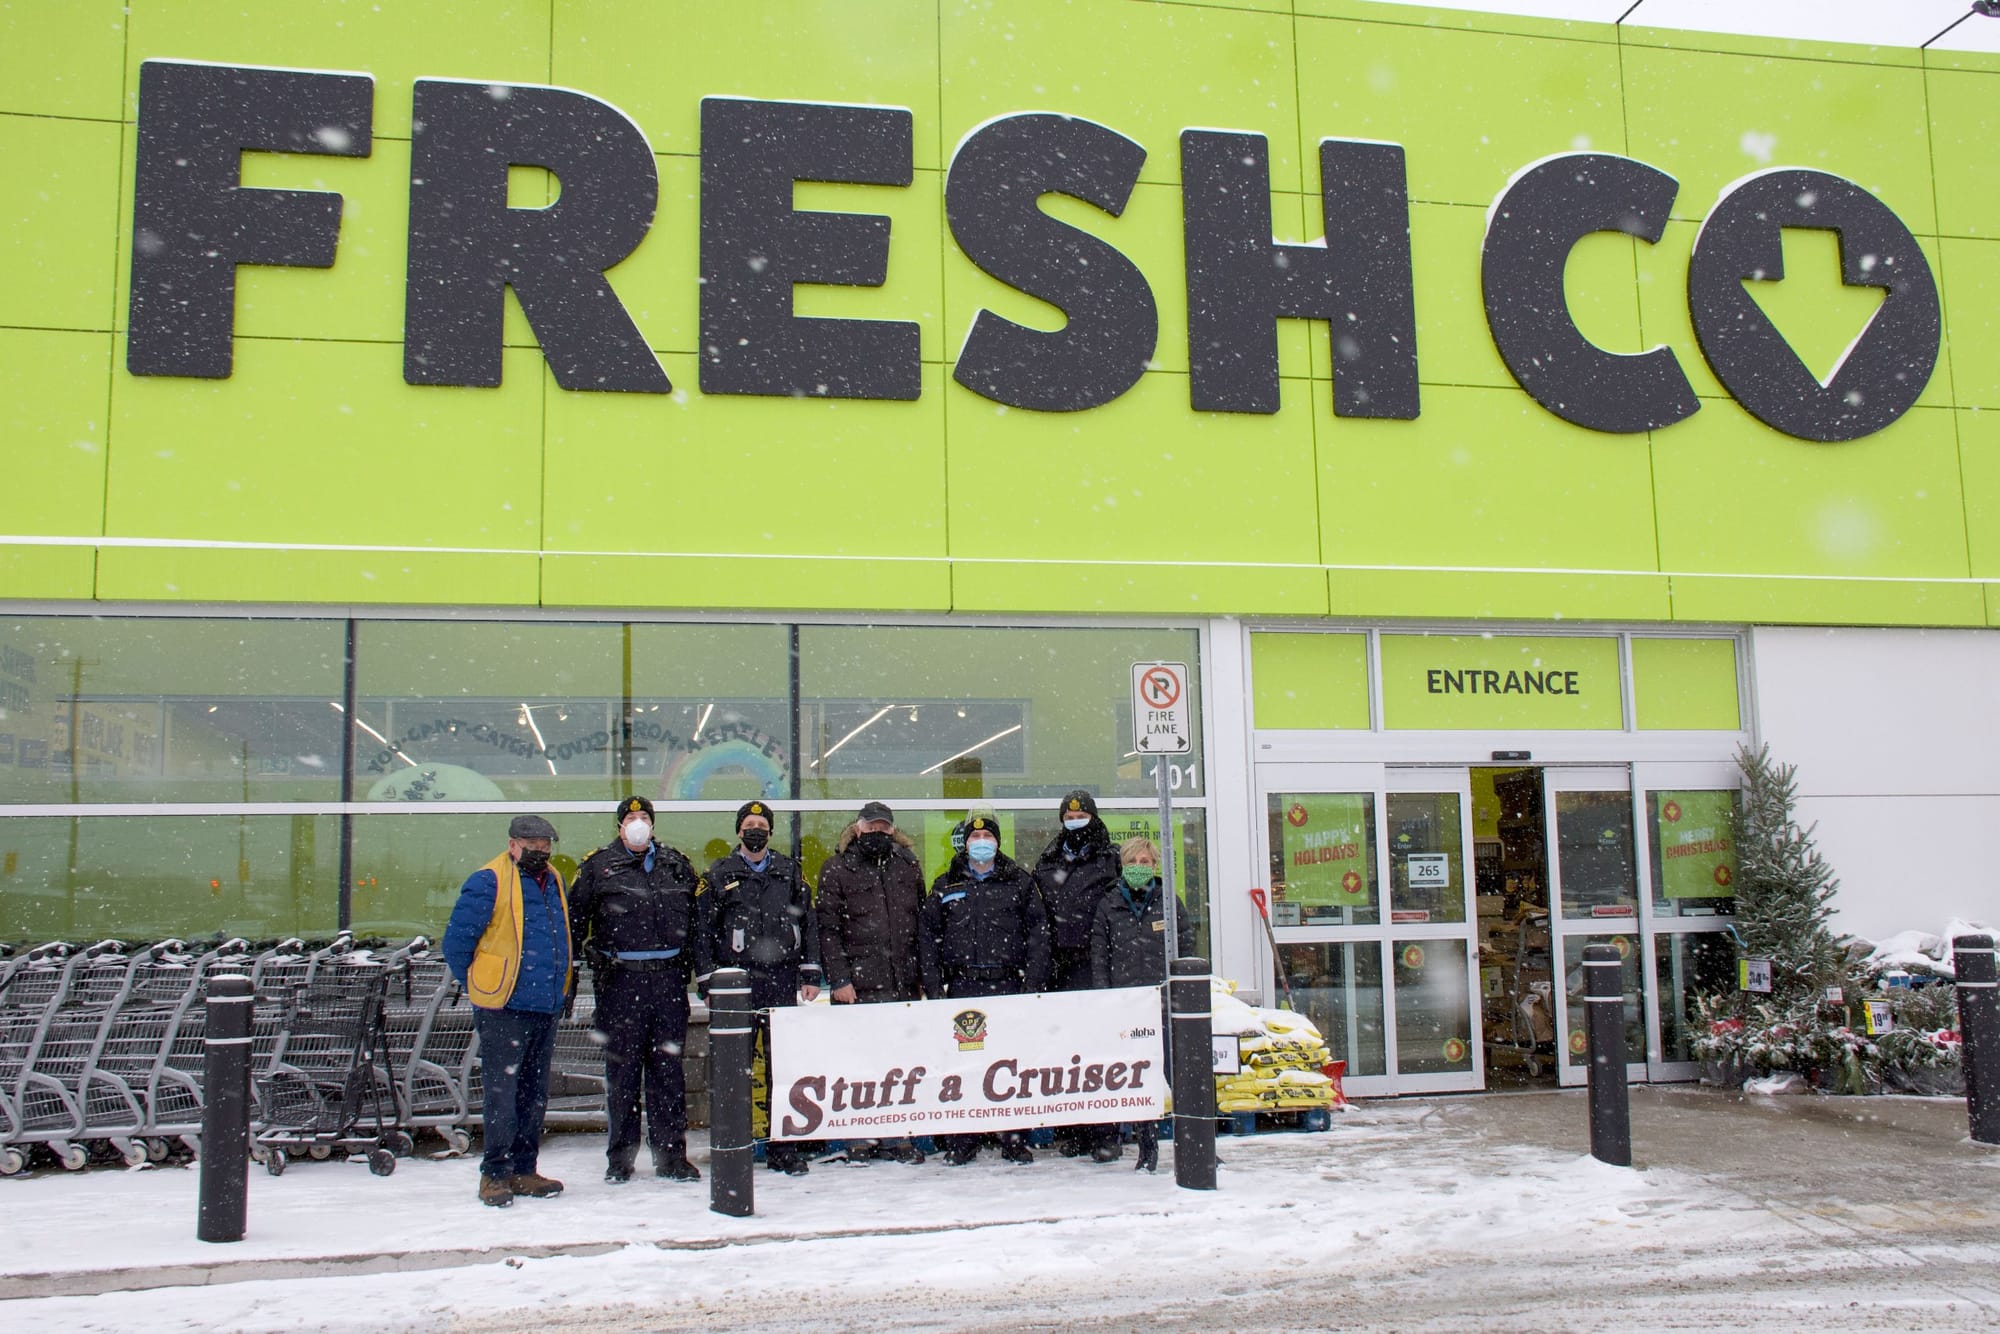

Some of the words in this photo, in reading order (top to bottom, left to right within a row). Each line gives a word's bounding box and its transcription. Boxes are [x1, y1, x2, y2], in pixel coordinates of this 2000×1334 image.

[1427, 669, 1580, 695] ENTRANCE
[1148, 711, 1176, 722] FIRE
[1146, 723, 1179, 735] LANE
[472, 723, 534, 760] CATCH
[543, 730, 610, 761] COVID
[703, 720, 783, 759] SMILE
[1149, 763, 1198, 790] 101
[1129, 820, 1142, 831] BE
[1143, 820, 1150, 830] A
[1679, 827, 1716, 843] MERRY
[1304, 828, 1351, 849] HAPPY
[1293, 842, 1360, 867] HOLIDAYS!
[1418, 865, 1440, 877] 265
[1130, 1027, 1156, 1037] alpha
[781, 1066, 926, 1137] Stuff
[938, 1074, 963, 1103] a
[982, 1054, 1151, 1102] Cruiser
[827, 1118, 848, 1128] ALL
[850, 1113, 907, 1126] PROCEEDS
[909, 1111, 926, 1121] GO
[928, 1111, 942, 1120] TO
[944, 1110, 966, 1119] THE
[968, 1107, 1011, 1118] CENTRE
[1013, 1101, 1085, 1116] WELLINGTON
[1087, 1097, 1118, 1110] FOOD
[1120, 1096, 1155, 1108] BANK.
